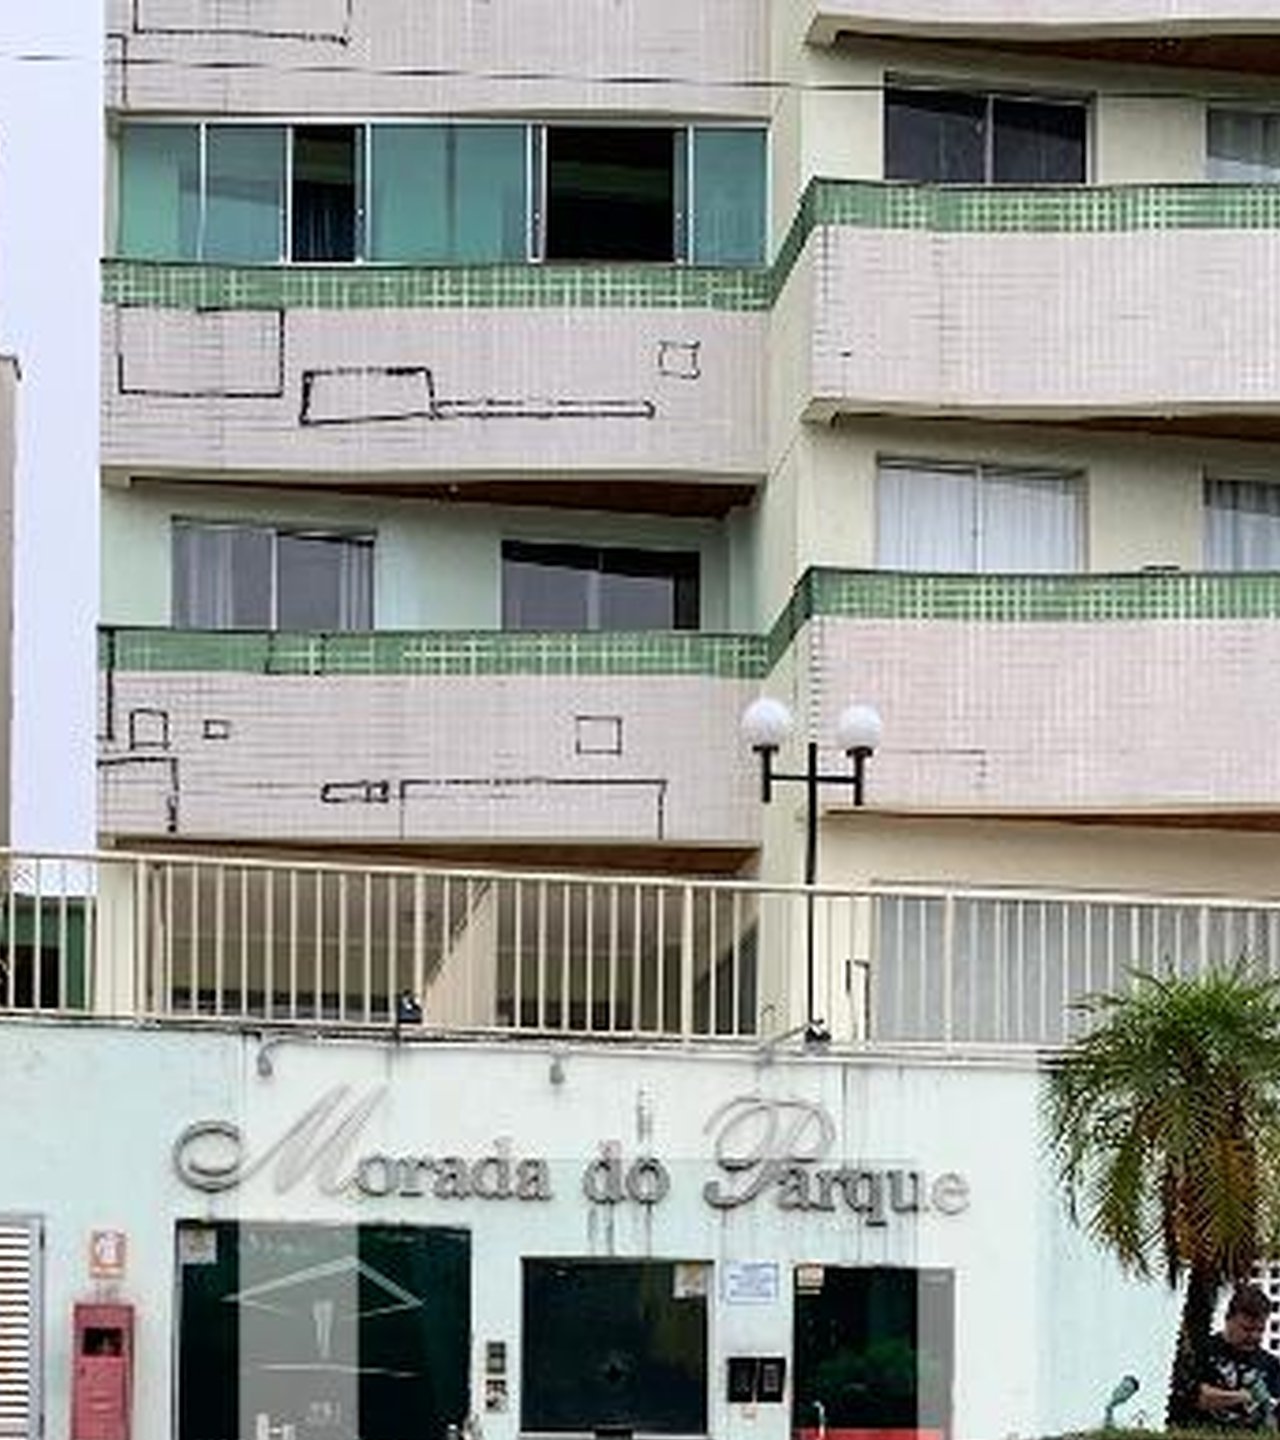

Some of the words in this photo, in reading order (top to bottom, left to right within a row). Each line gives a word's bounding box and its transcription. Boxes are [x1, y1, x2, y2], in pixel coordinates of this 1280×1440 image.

[174, 1083, 552, 1202] Morada
[583, 1140, 670, 1205] do
[703, 1097, 970, 1228] Parque
